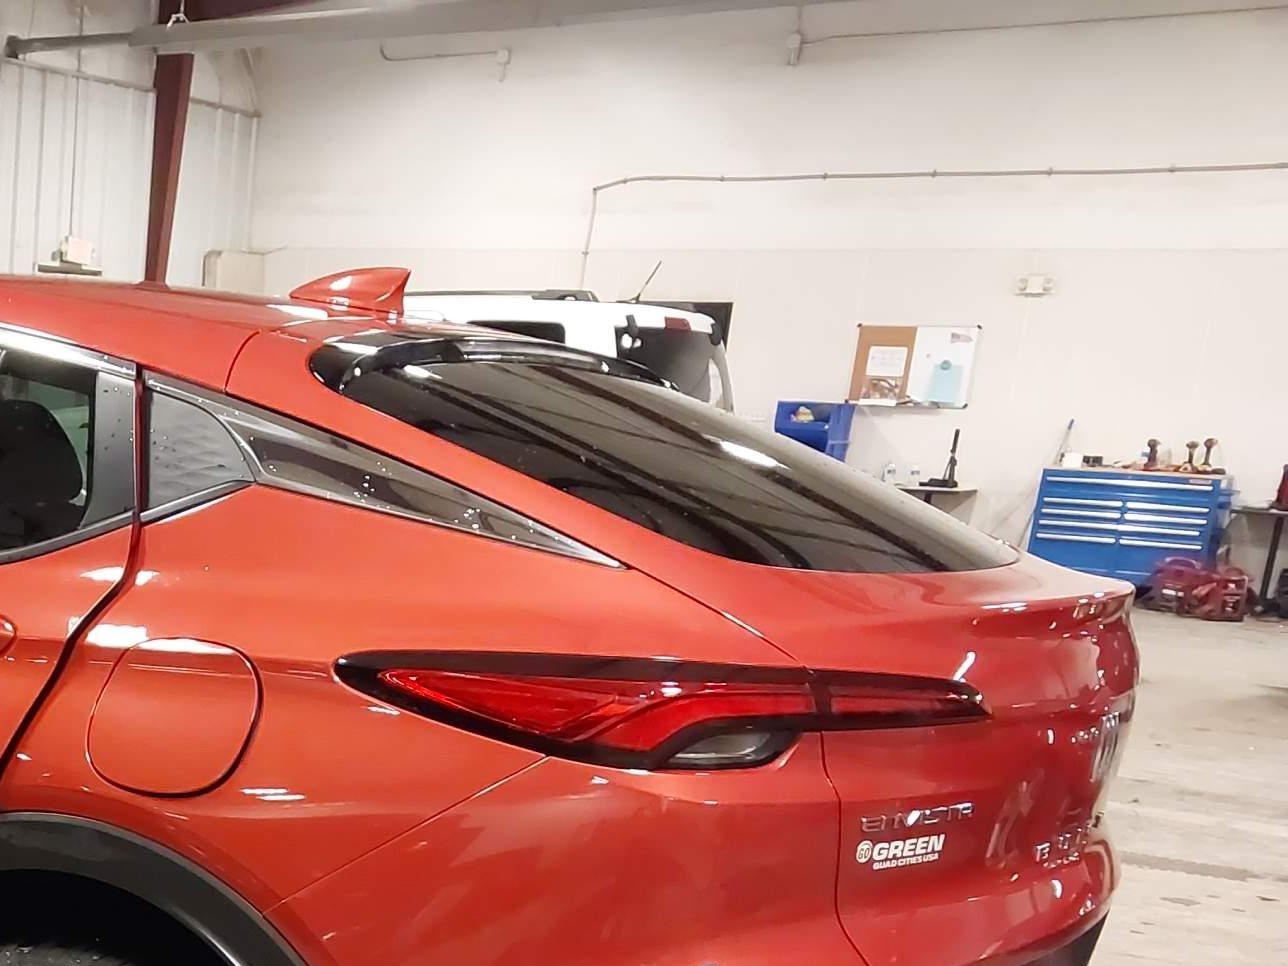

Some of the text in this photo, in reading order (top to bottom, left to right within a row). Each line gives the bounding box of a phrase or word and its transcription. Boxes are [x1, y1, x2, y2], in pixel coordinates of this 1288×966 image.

[872, 834, 945, 861] GREEN
[872, 853, 939, 870] QUAD CITIES USA
